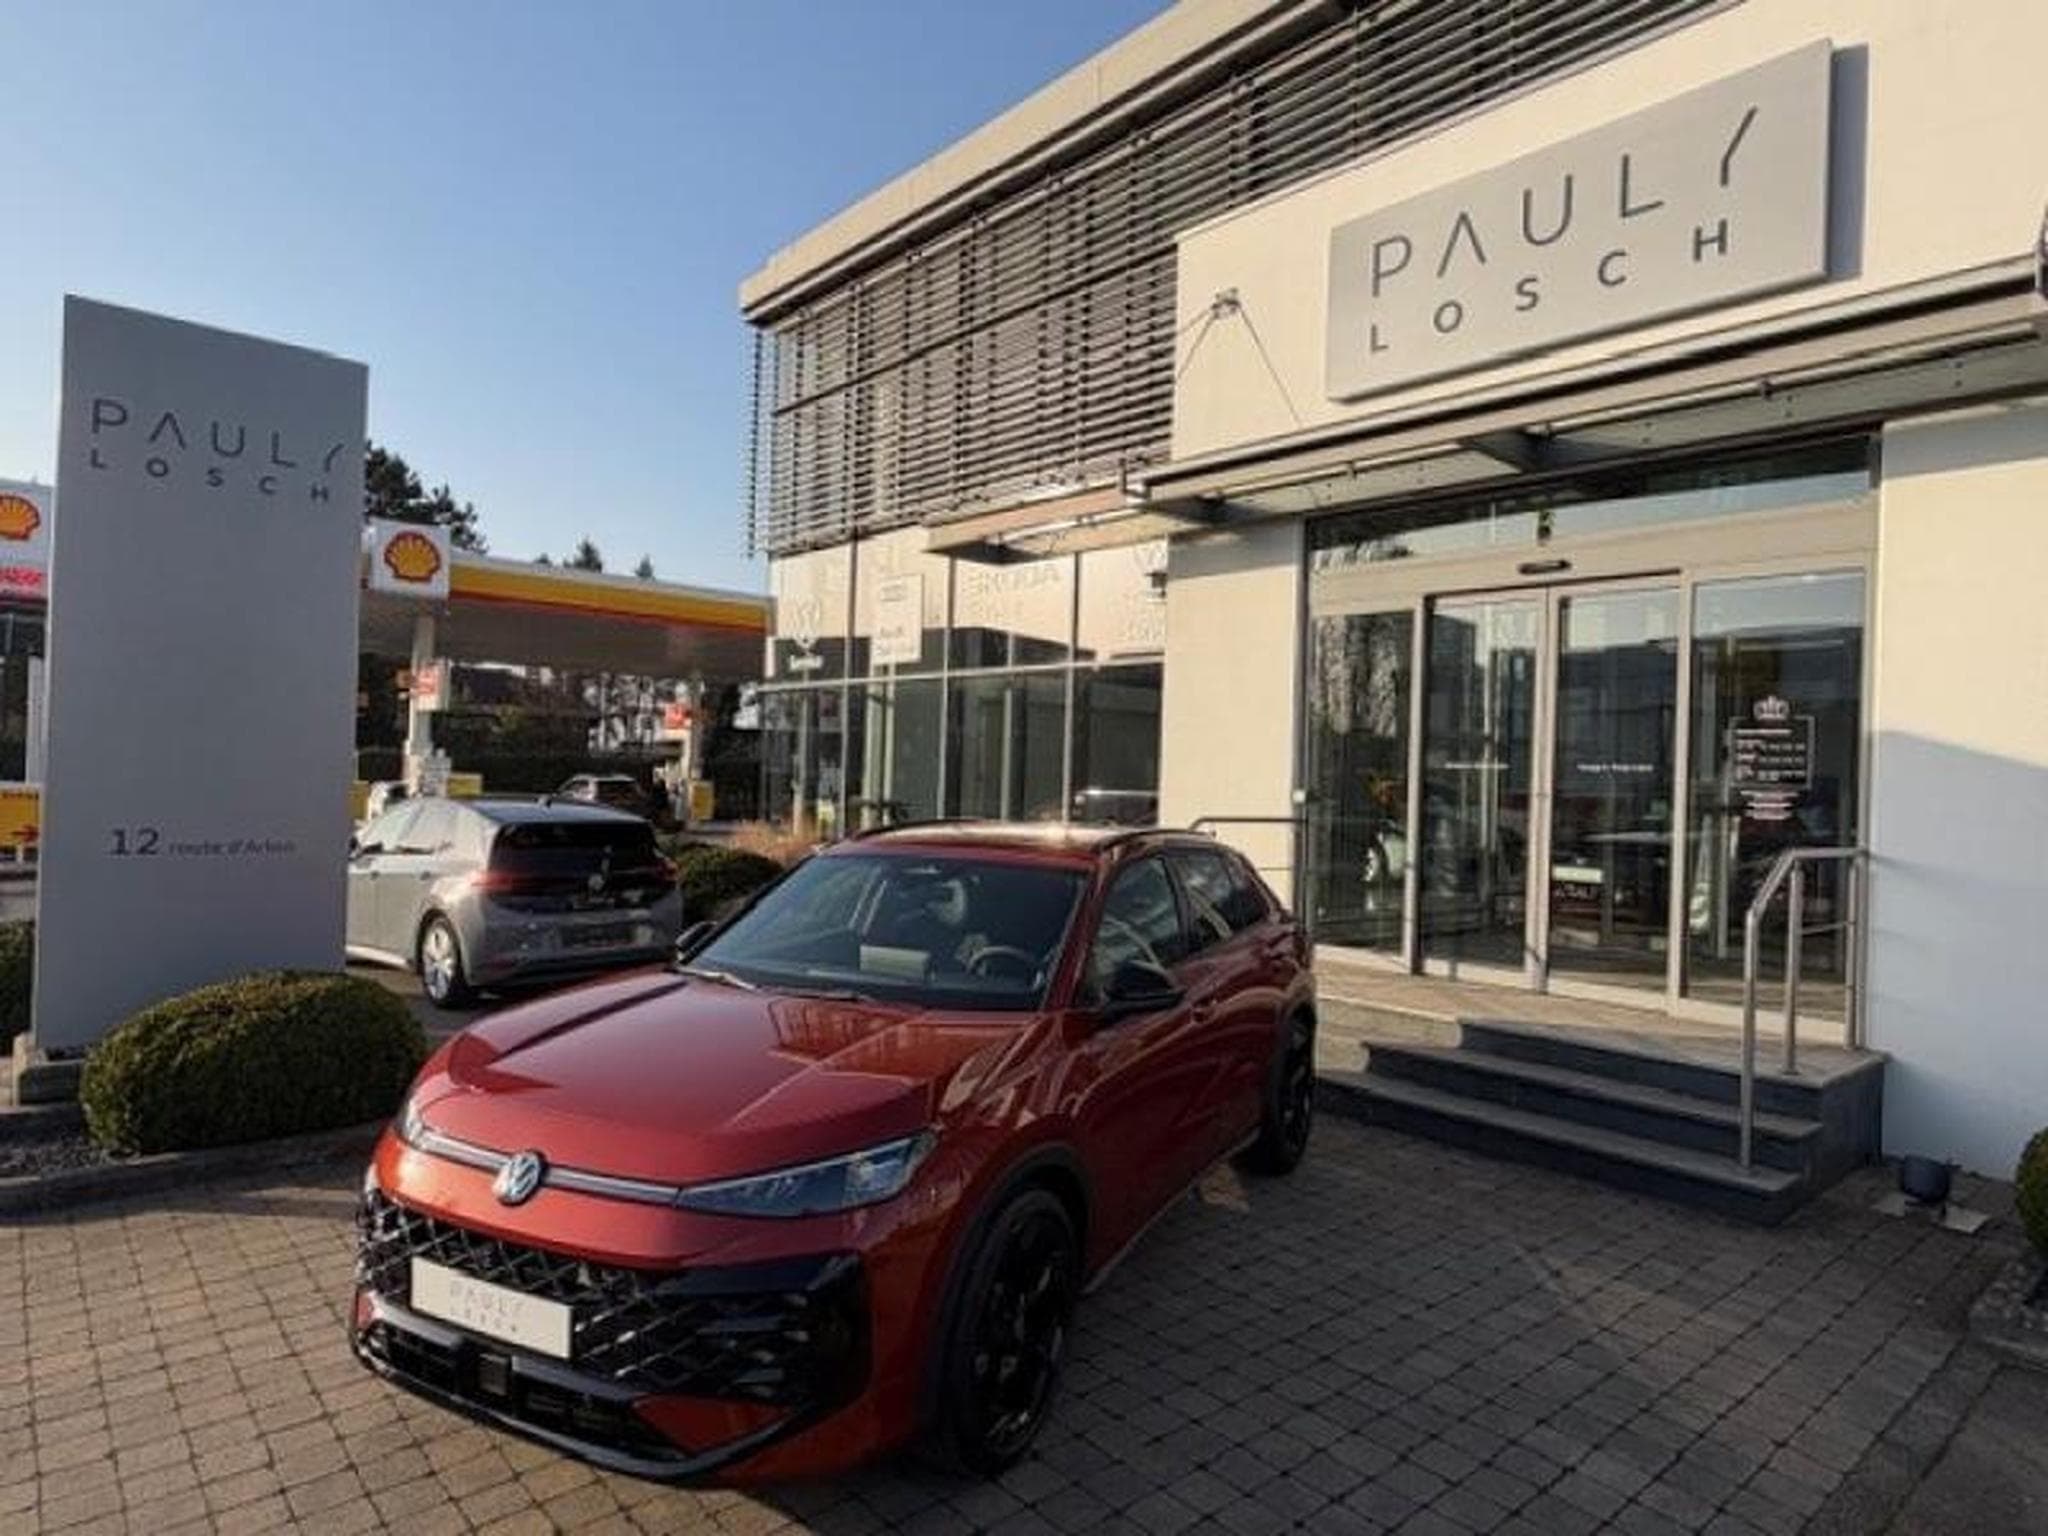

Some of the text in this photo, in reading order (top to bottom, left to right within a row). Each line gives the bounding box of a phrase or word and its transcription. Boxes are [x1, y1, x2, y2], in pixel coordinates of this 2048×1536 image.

[1371, 104, 1758, 298] PAULY
[1369, 218, 1729, 354] LOSCH
[91, 398, 345, 473] PAULY
[90, 449, 329, 502] LOSCH
[110, 828, 160, 857] 12
